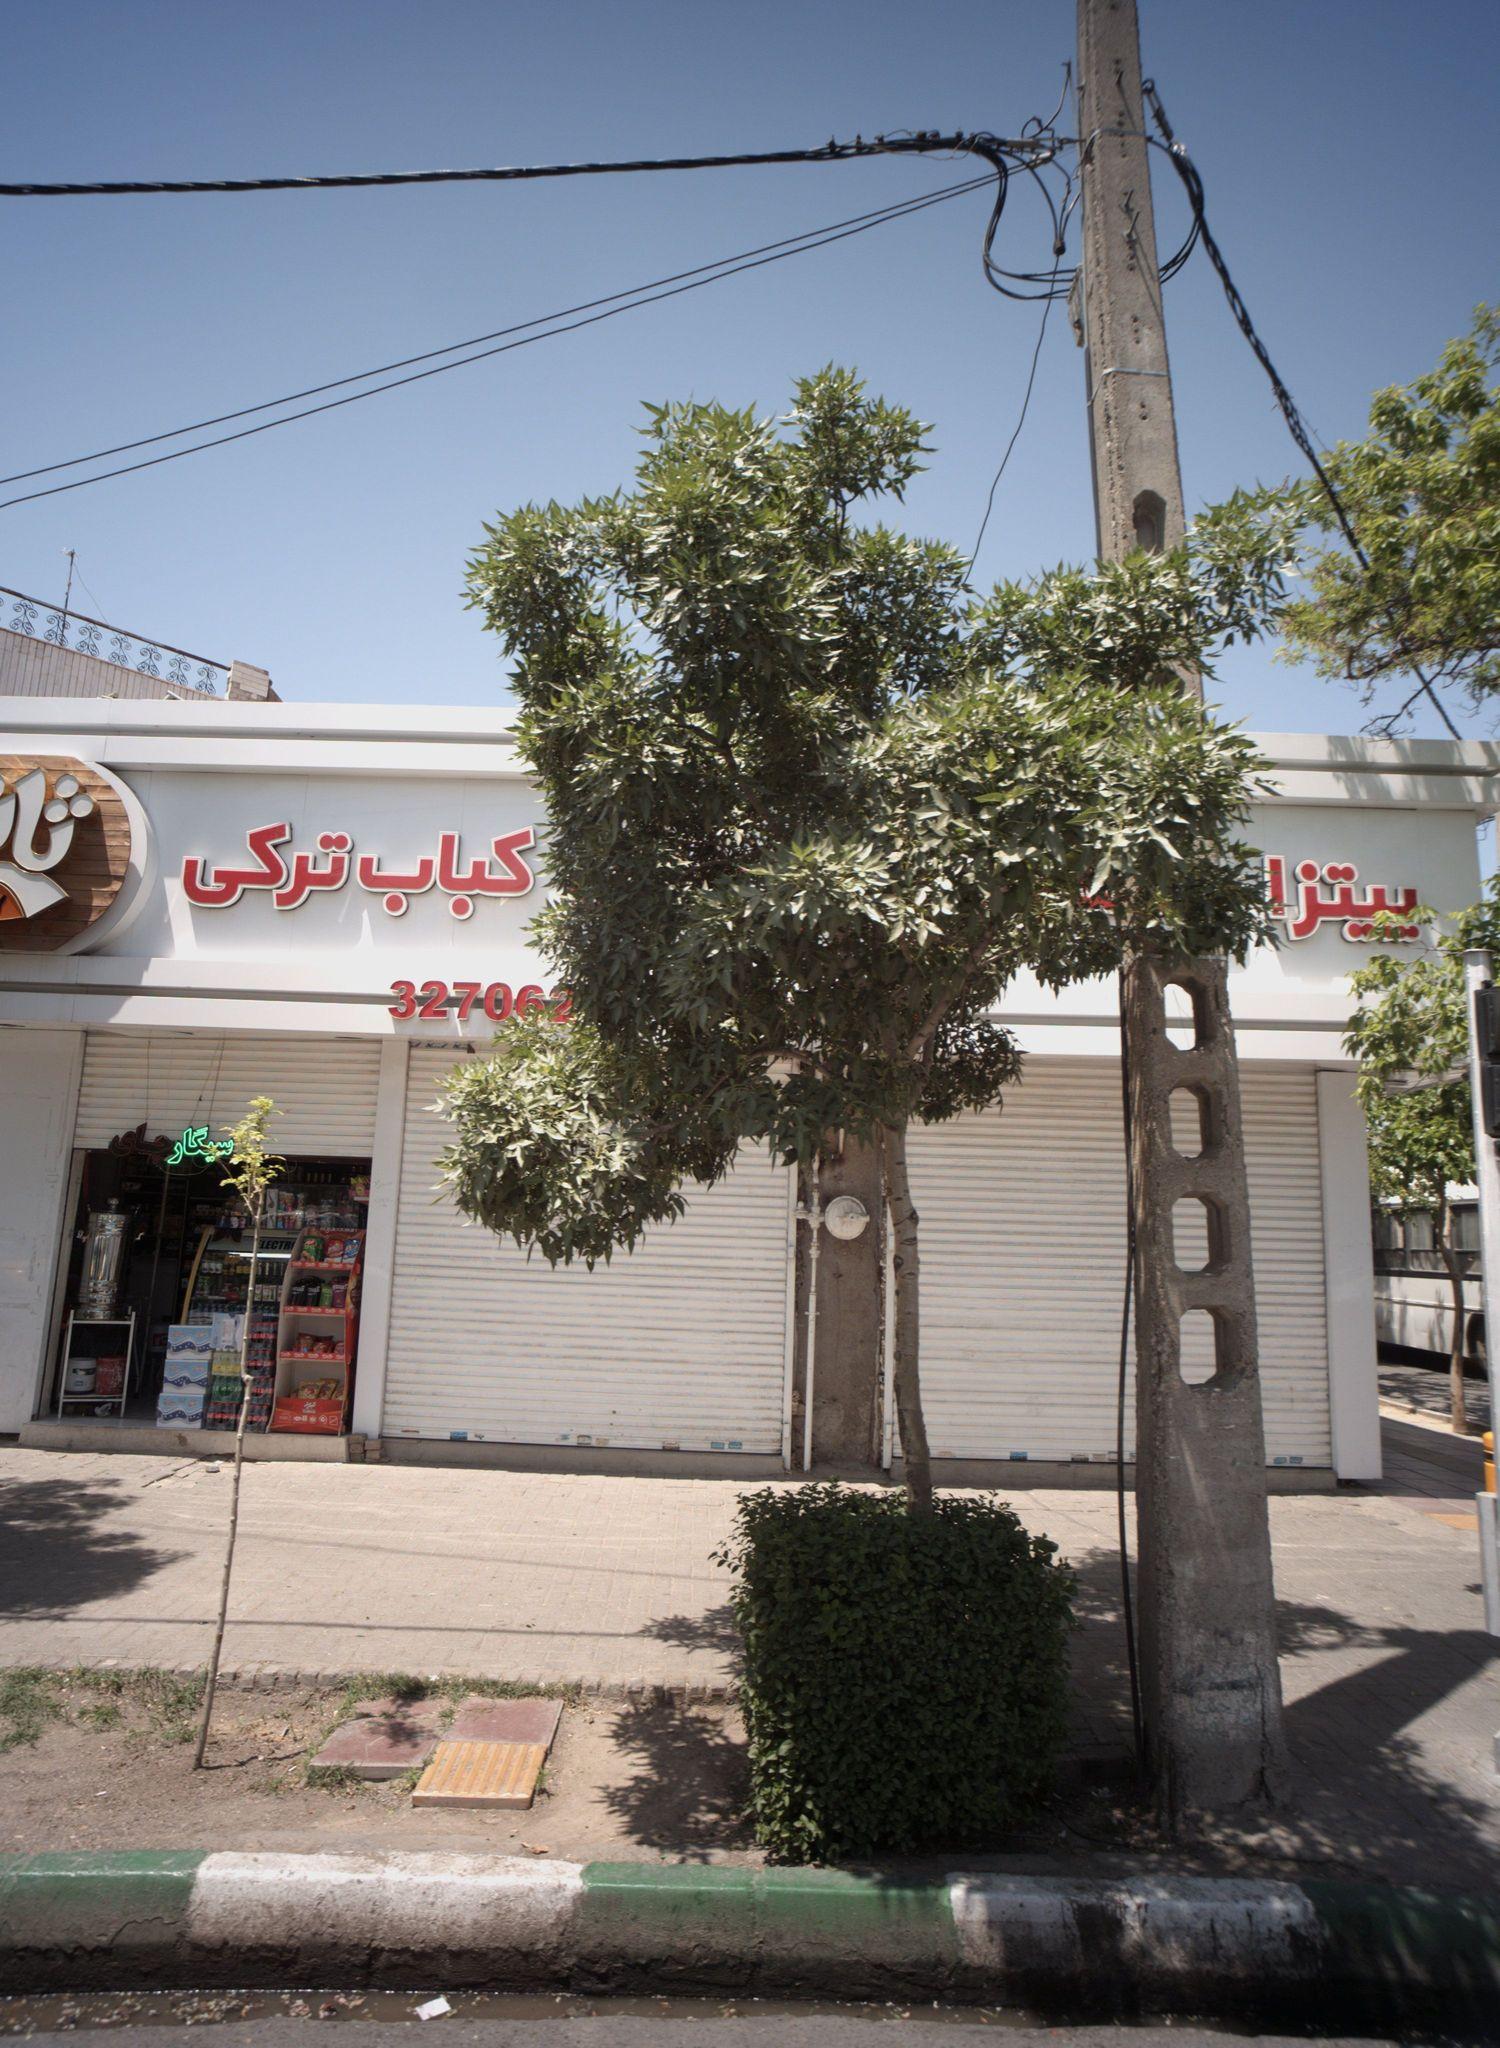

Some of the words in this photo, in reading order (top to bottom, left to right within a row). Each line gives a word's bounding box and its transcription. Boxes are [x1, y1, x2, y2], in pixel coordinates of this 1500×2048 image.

[181, 821, 352, 911] ترکی
[357, 825, 536, 920] کباب
[1264, 854, 1420, 943] پیتزا
[166, 1125, 235, 1165] سیگار
